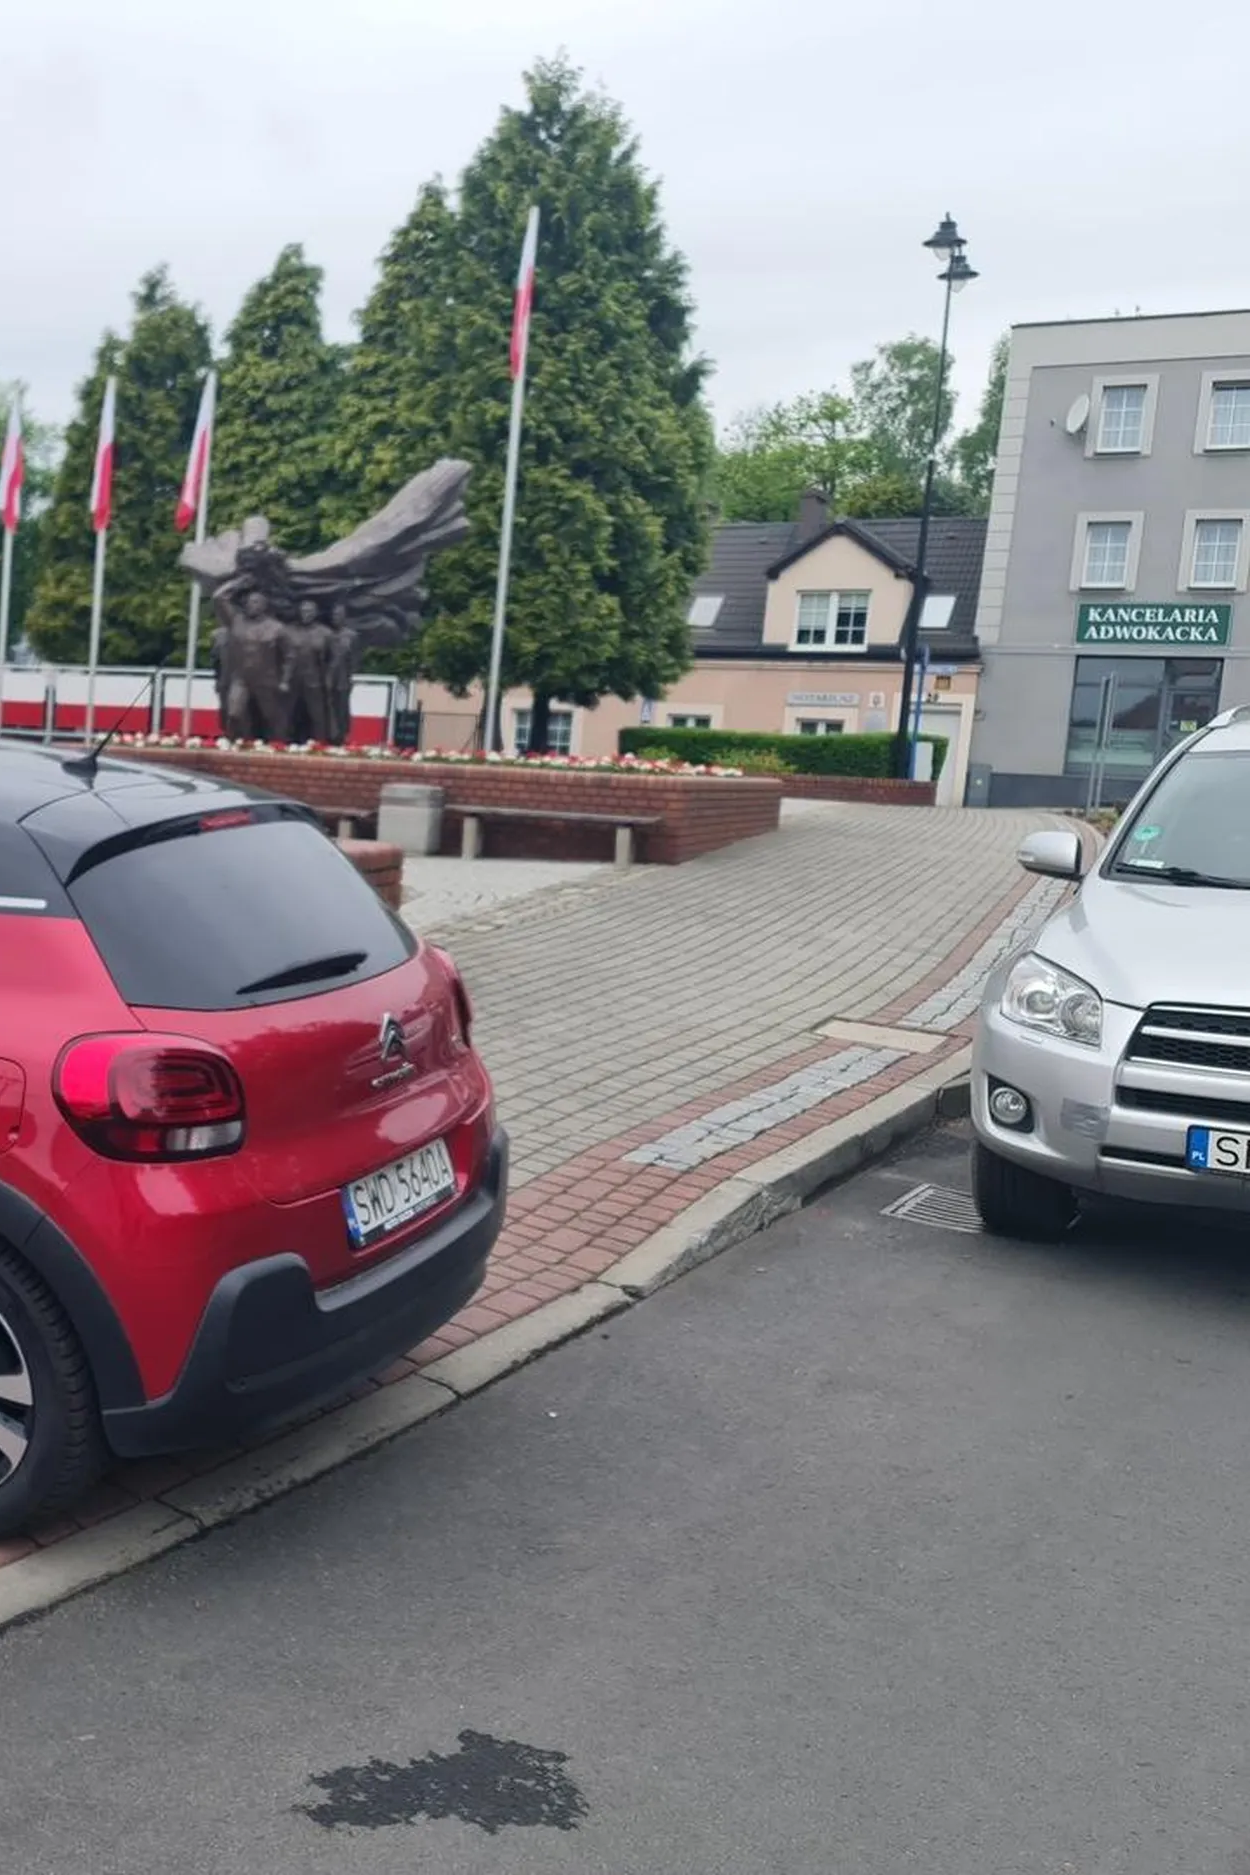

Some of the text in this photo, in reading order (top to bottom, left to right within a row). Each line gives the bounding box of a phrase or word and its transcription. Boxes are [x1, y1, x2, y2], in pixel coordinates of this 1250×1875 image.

[1088, 607, 1219, 623] KANCELARIA
[1084, 624, 1219, 641] ADWOKACKA
[1192, 1150, 1205, 1161] PL
[1215, 1136, 1250, 1169] S
[354, 1172, 395, 1225] SWD
[395, 1142, 449, 1204] 5640A
